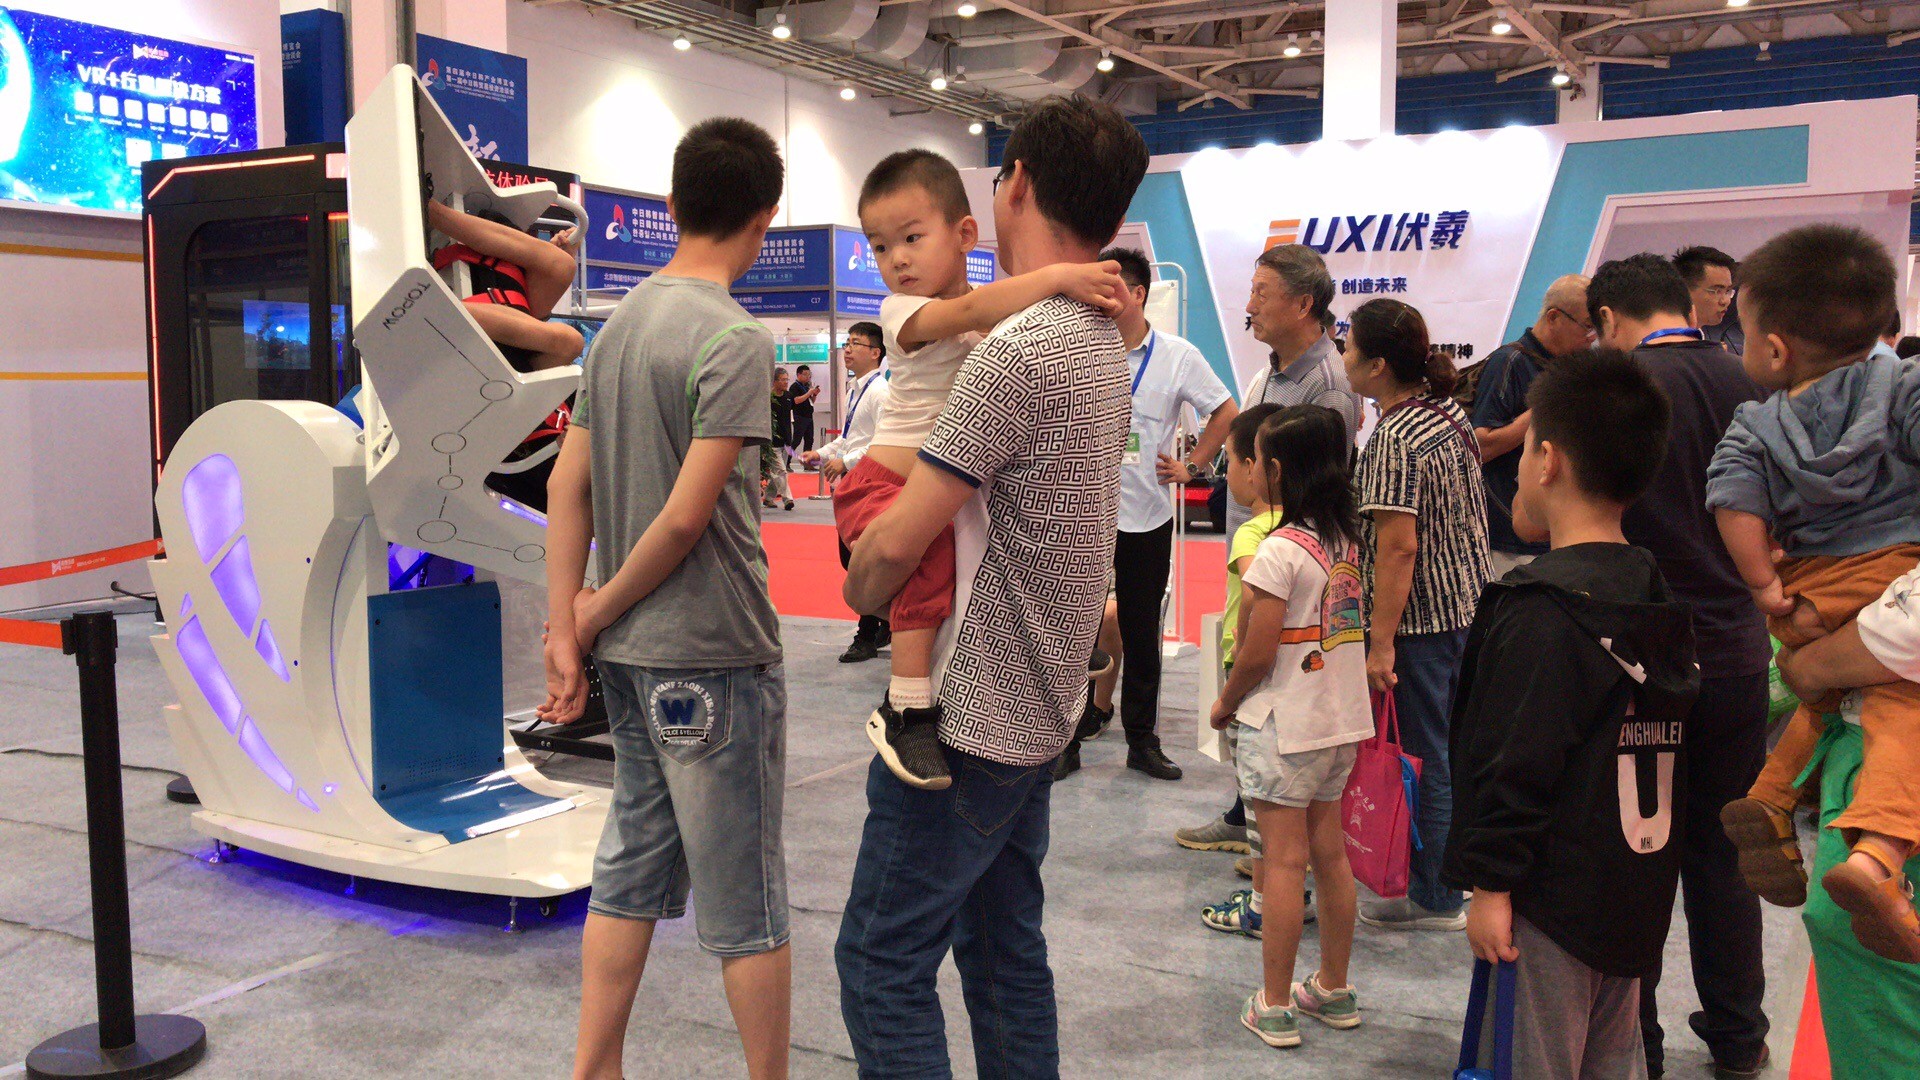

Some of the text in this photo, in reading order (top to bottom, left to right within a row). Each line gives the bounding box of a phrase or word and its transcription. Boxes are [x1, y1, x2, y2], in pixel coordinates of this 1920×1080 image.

[632, 207, 675, 222] 中日韩智能制
[1341, 276, 1407, 295] 创造未来
[382, 282, 431, 331] TOPOW
[659, 698, 695, 725] W
[1617, 751, 1675, 854] U
